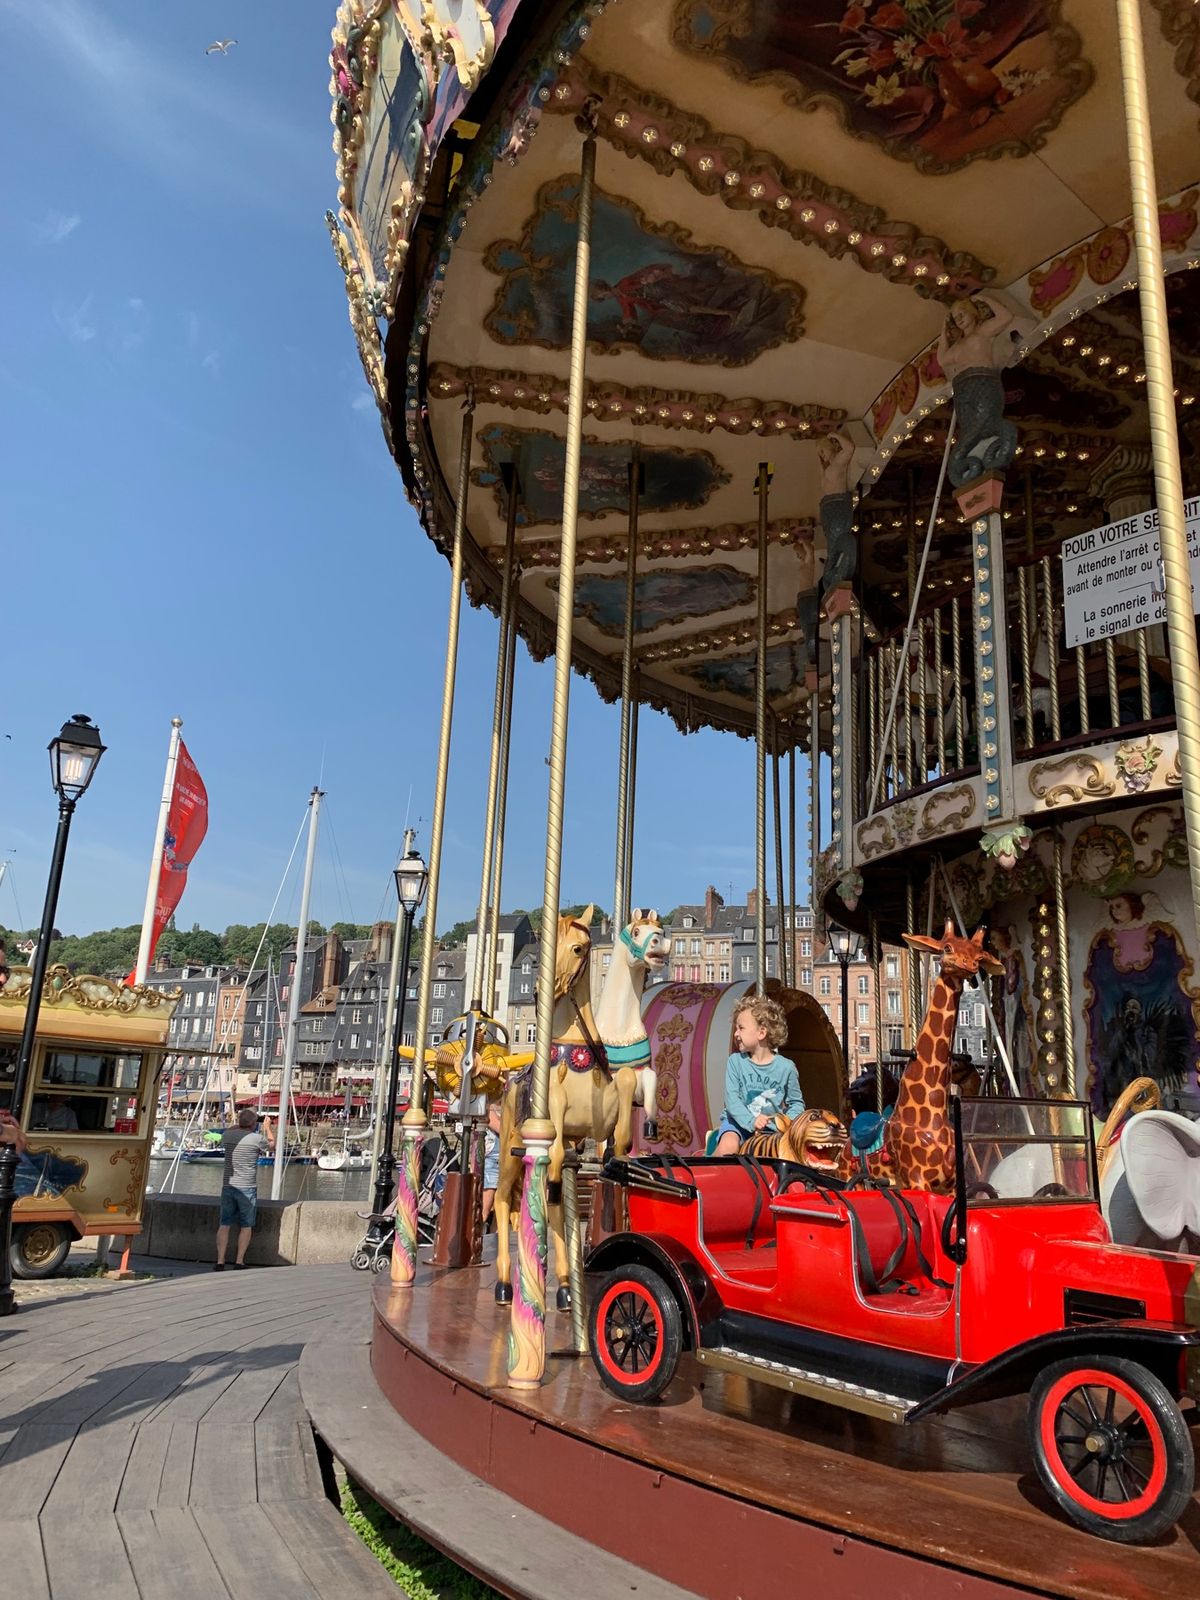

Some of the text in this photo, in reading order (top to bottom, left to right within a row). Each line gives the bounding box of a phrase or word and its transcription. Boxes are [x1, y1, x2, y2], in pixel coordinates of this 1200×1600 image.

[1065, 535, 1096, 558] POUR
[1100, 518, 1138, 544] VOTRE
[1077, 555, 1117, 576] Attendre
[1120, 542, 1149, 561] l'arrêt
[1066, 560, 1153, 596] avant de monter ou
[1083, 610, 1096, 623] La
[1100, 595, 1147, 618] sonnerie
[1085, 626, 1096, 638] le
[1099, 615, 1131, 634] signal
[1135, 611, 1149, 624] de
